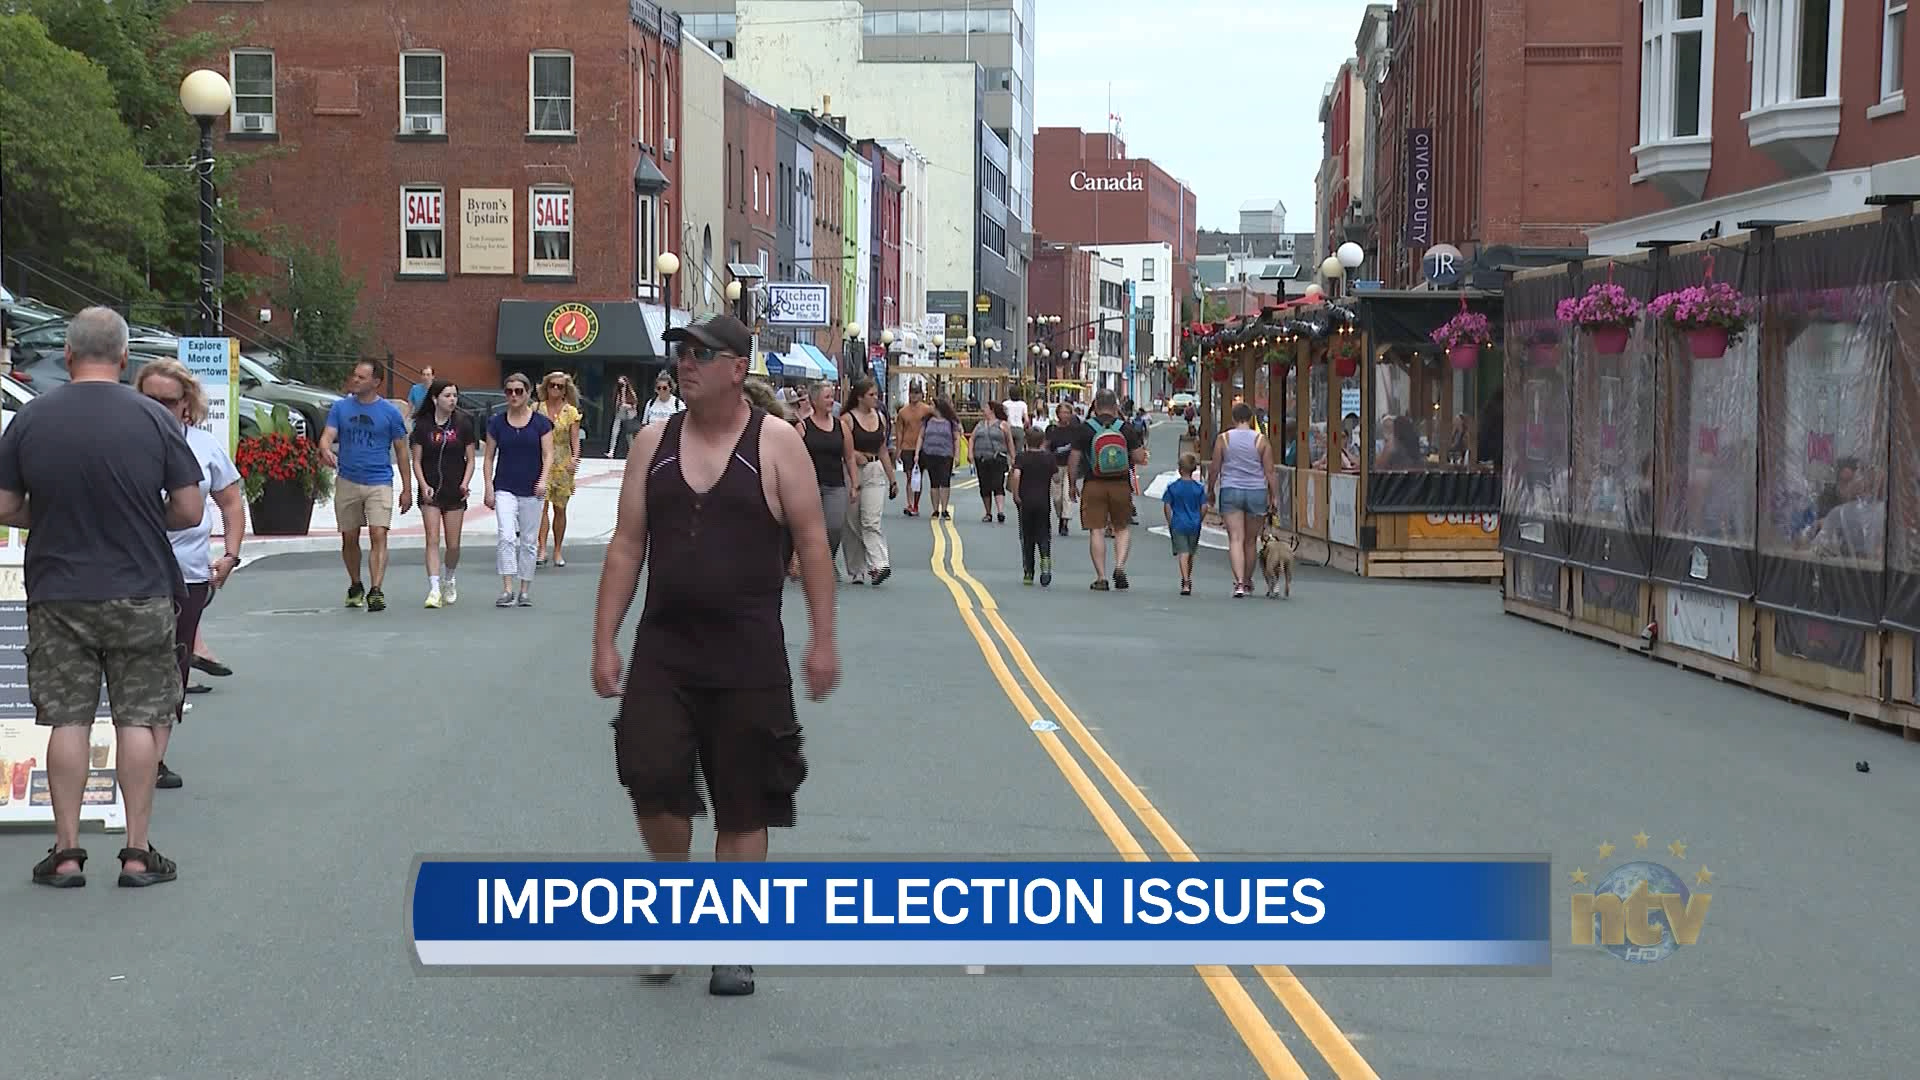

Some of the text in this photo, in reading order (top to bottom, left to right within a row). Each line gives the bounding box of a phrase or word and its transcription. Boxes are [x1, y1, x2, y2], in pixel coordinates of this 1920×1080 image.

[1070, 170, 1144, 191] Canada
[1412, 133, 1429, 243] CIVIC DUTY
[408, 195, 440, 225] SALE
[467, 198, 507, 214] Byron's
[537, 197, 569, 227] SALE
[466, 211, 509, 227] Upstairs
[1433, 252, 1456, 278] JR
[775, 289, 820, 304] Kitchen
[781, 301, 820, 315] Queen
[188, 340, 222, 351] Explore
[187, 352, 223, 363] More of
[189, 367, 228, 376] owntown
